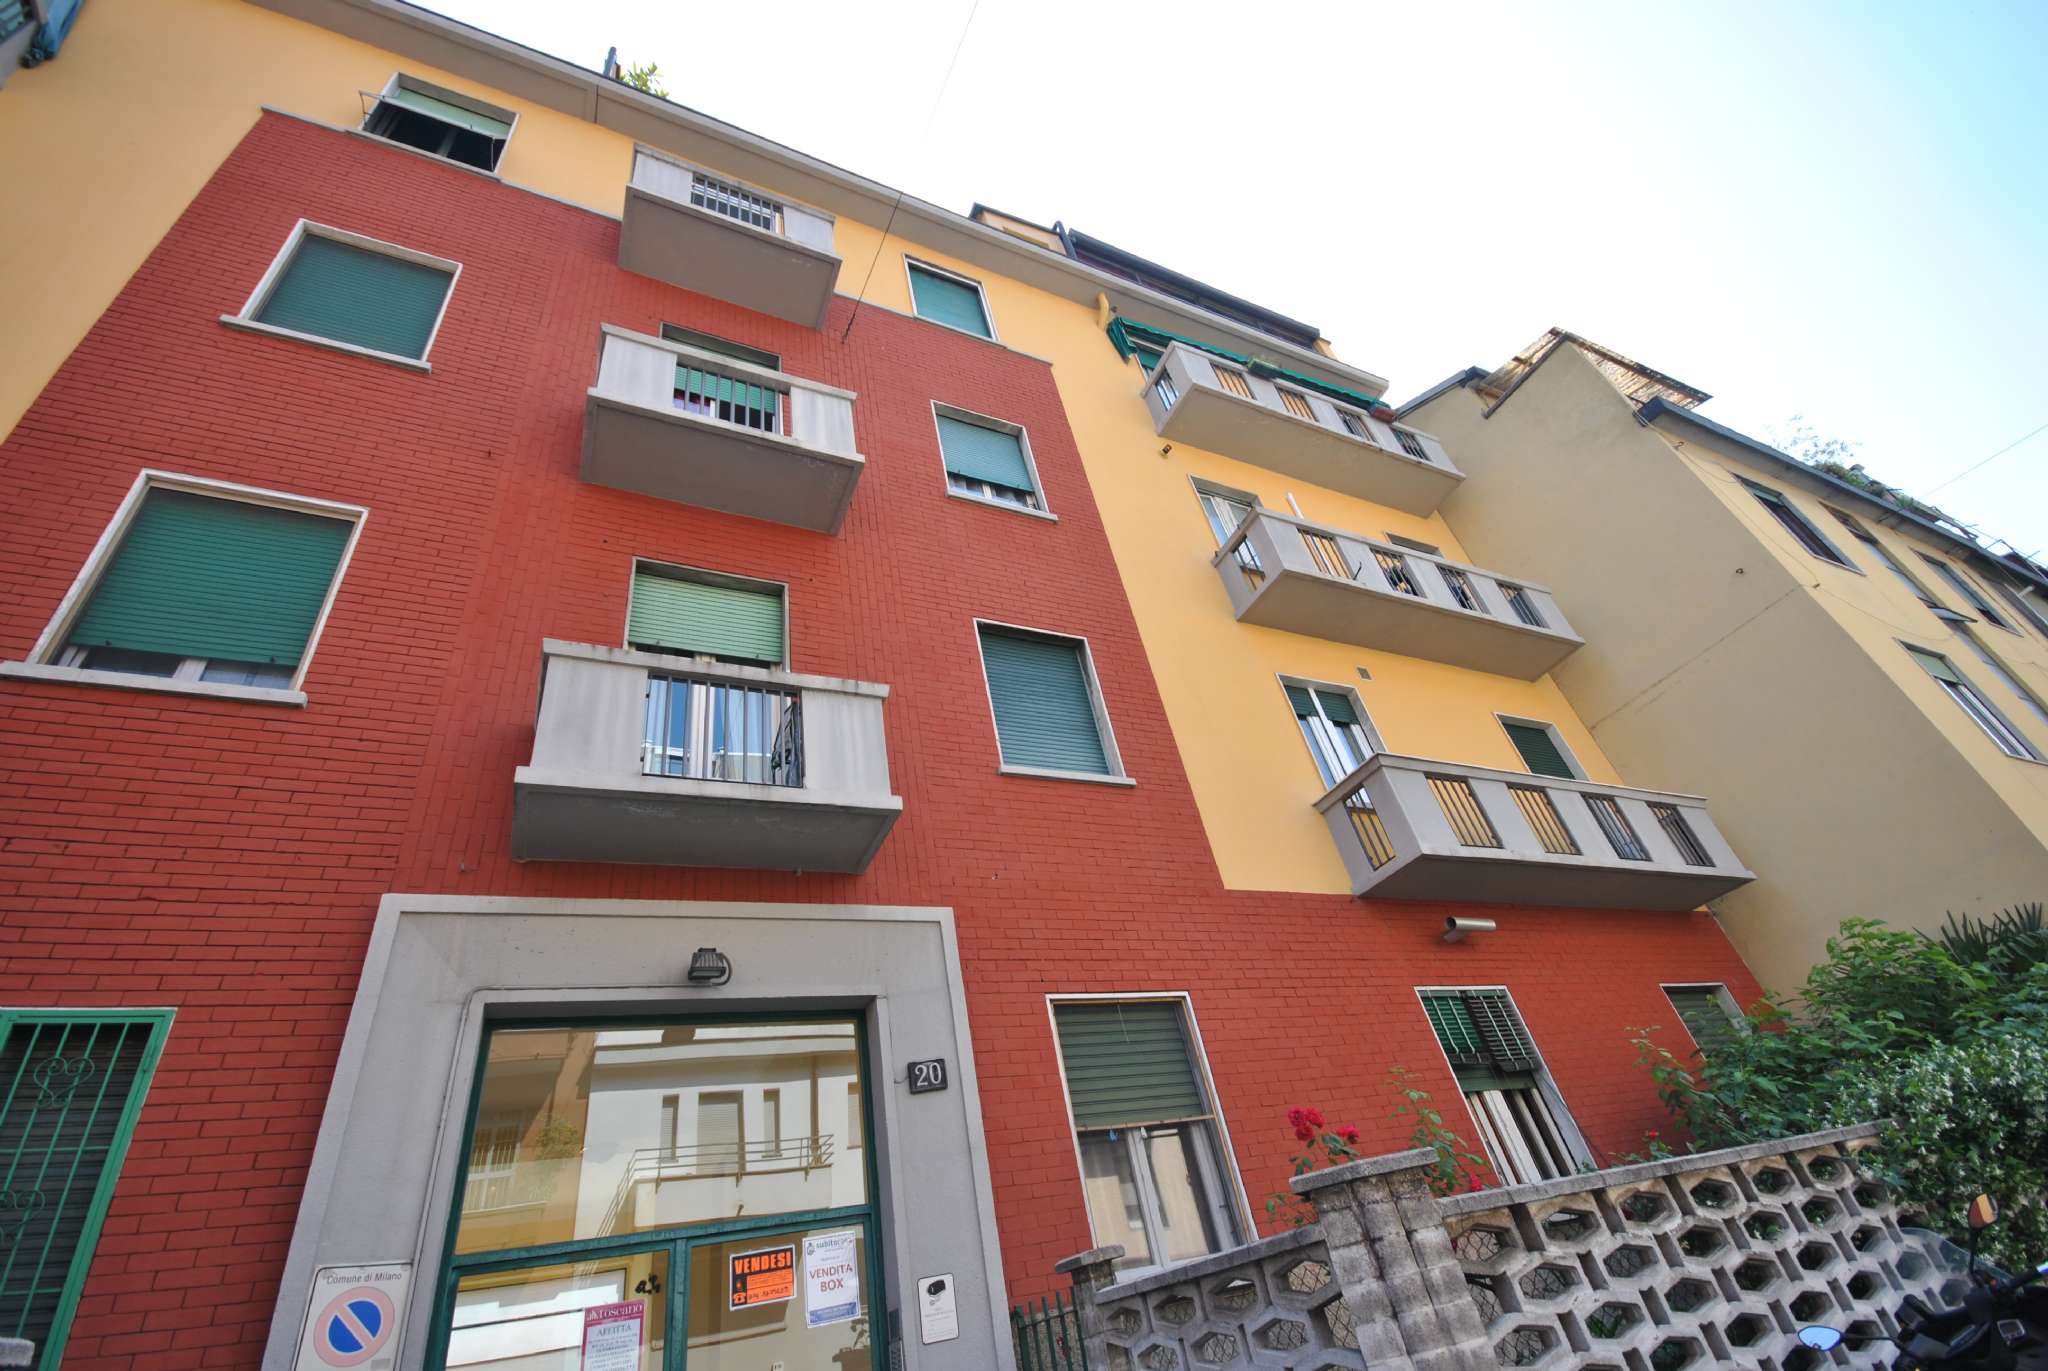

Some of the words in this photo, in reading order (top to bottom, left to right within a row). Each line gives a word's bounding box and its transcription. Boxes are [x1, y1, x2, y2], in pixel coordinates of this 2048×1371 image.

[915, 1062, 942, 1087] 20
[735, 1251, 791, 1275] VENDESI
[326, 1275, 362, 1285] Comune
[363, 1273, 373, 1283] di
[373, 1271, 402, 1281] Milano
[809, 1264, 854, 1280] VENDITA
[820, 1279, 844, 1293] BOX
